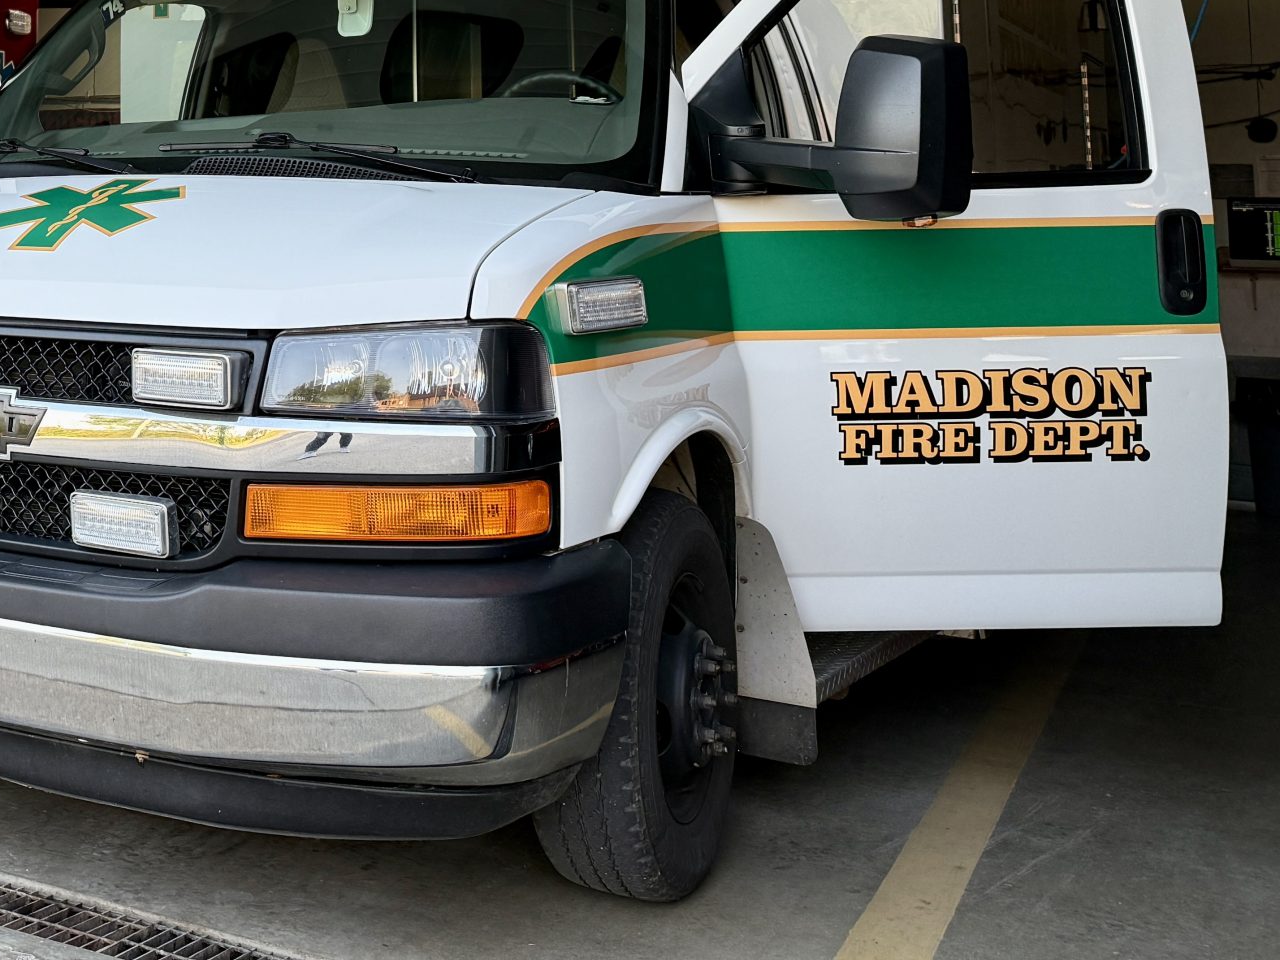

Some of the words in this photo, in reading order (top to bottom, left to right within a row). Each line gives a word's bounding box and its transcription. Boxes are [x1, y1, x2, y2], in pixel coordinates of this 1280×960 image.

[830, 367, 1152, 420] MADISON
[839, 422, 980, 465] FIRE
[988, 419, 1150, 463] DEPT.
